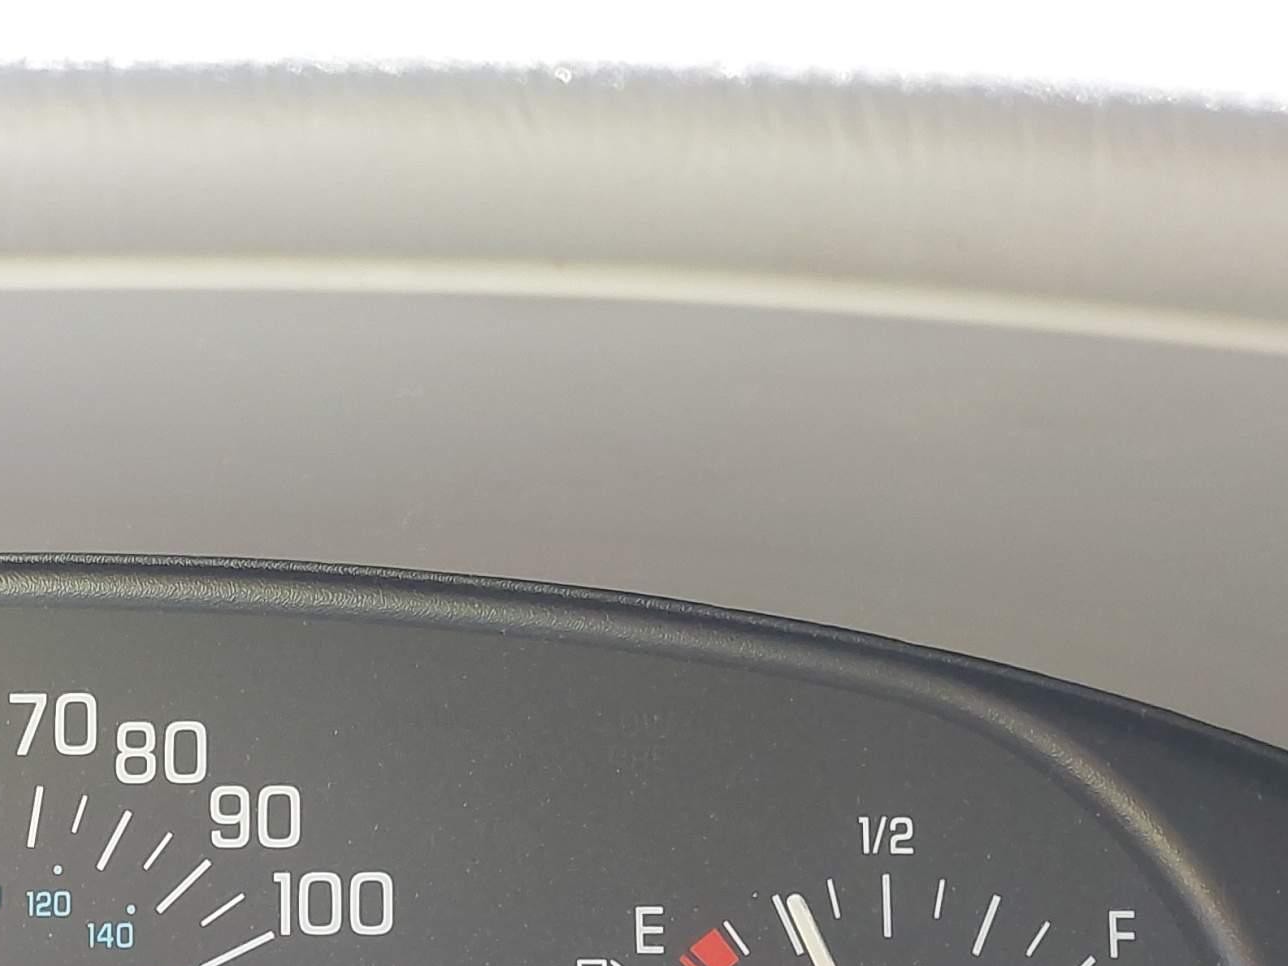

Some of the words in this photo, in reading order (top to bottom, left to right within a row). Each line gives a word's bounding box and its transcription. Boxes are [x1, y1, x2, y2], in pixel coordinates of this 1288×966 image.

[9, 692, 97, 756] 70
[115, 720, 207, 784] 80
[210, 785, 301, 848] 90
[858, 816, 914, 855] 1/2
[26, 890, 71, 917] 120
[272, 871, 393, 936] 100
[87, 922, 134, 949] 140
[635, 906, 665, 954] E
[1108, 910, 1135, 959] F
